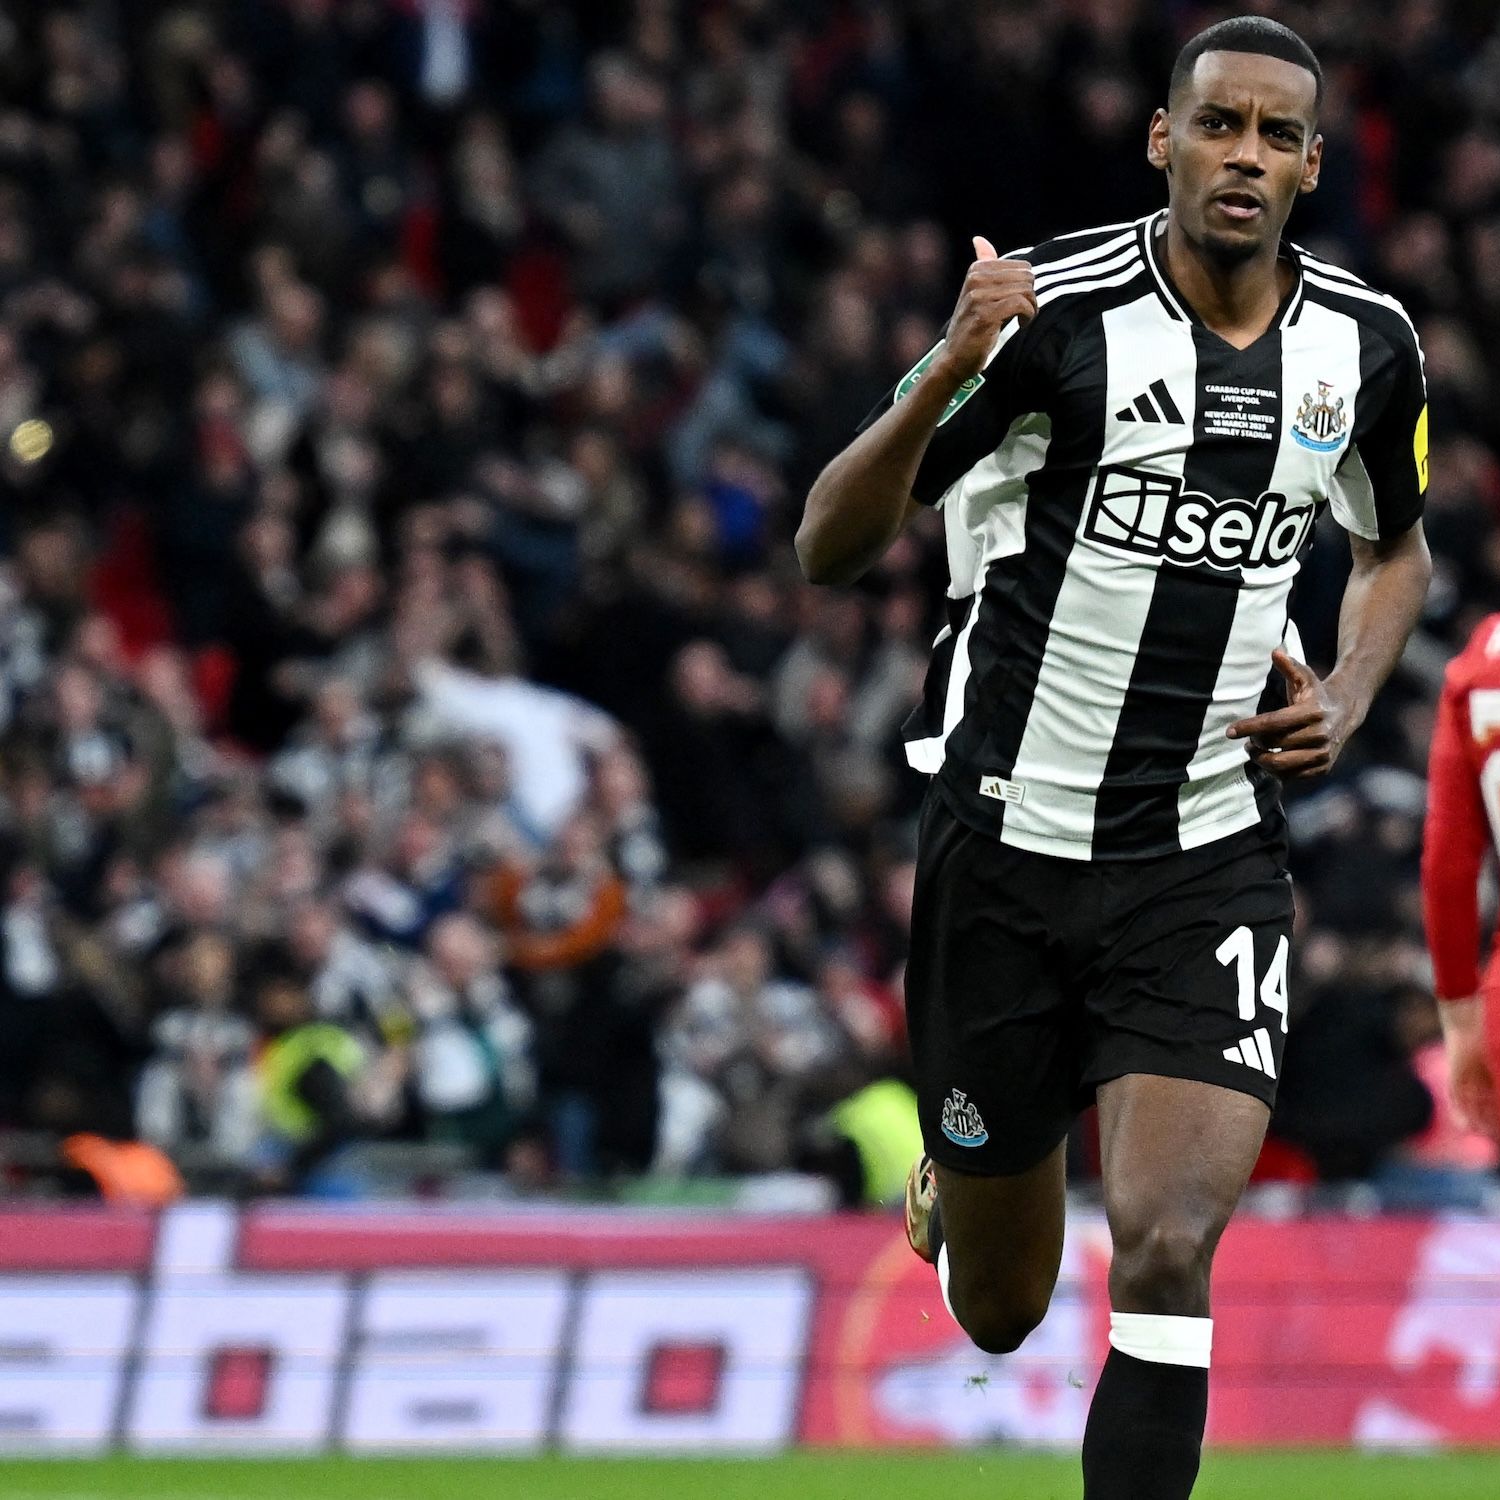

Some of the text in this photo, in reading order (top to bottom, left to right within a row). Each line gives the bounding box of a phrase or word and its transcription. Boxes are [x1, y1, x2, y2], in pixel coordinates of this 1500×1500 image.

[1205, 385, 1277, 398] CARABAO CUP FINAL
[1221, 394, 1260, 405] LIVERPOOL
[1204, 411, 1275, 423] NEWCASTLE UNITED
[1221, 420, 1248, 429] MARCH
[1204, 426, 1273, 440] WEMBLEY STADIUM
[1167, 500, 1309, 562] sela
[1215, 925, 1289, 1034] 14
